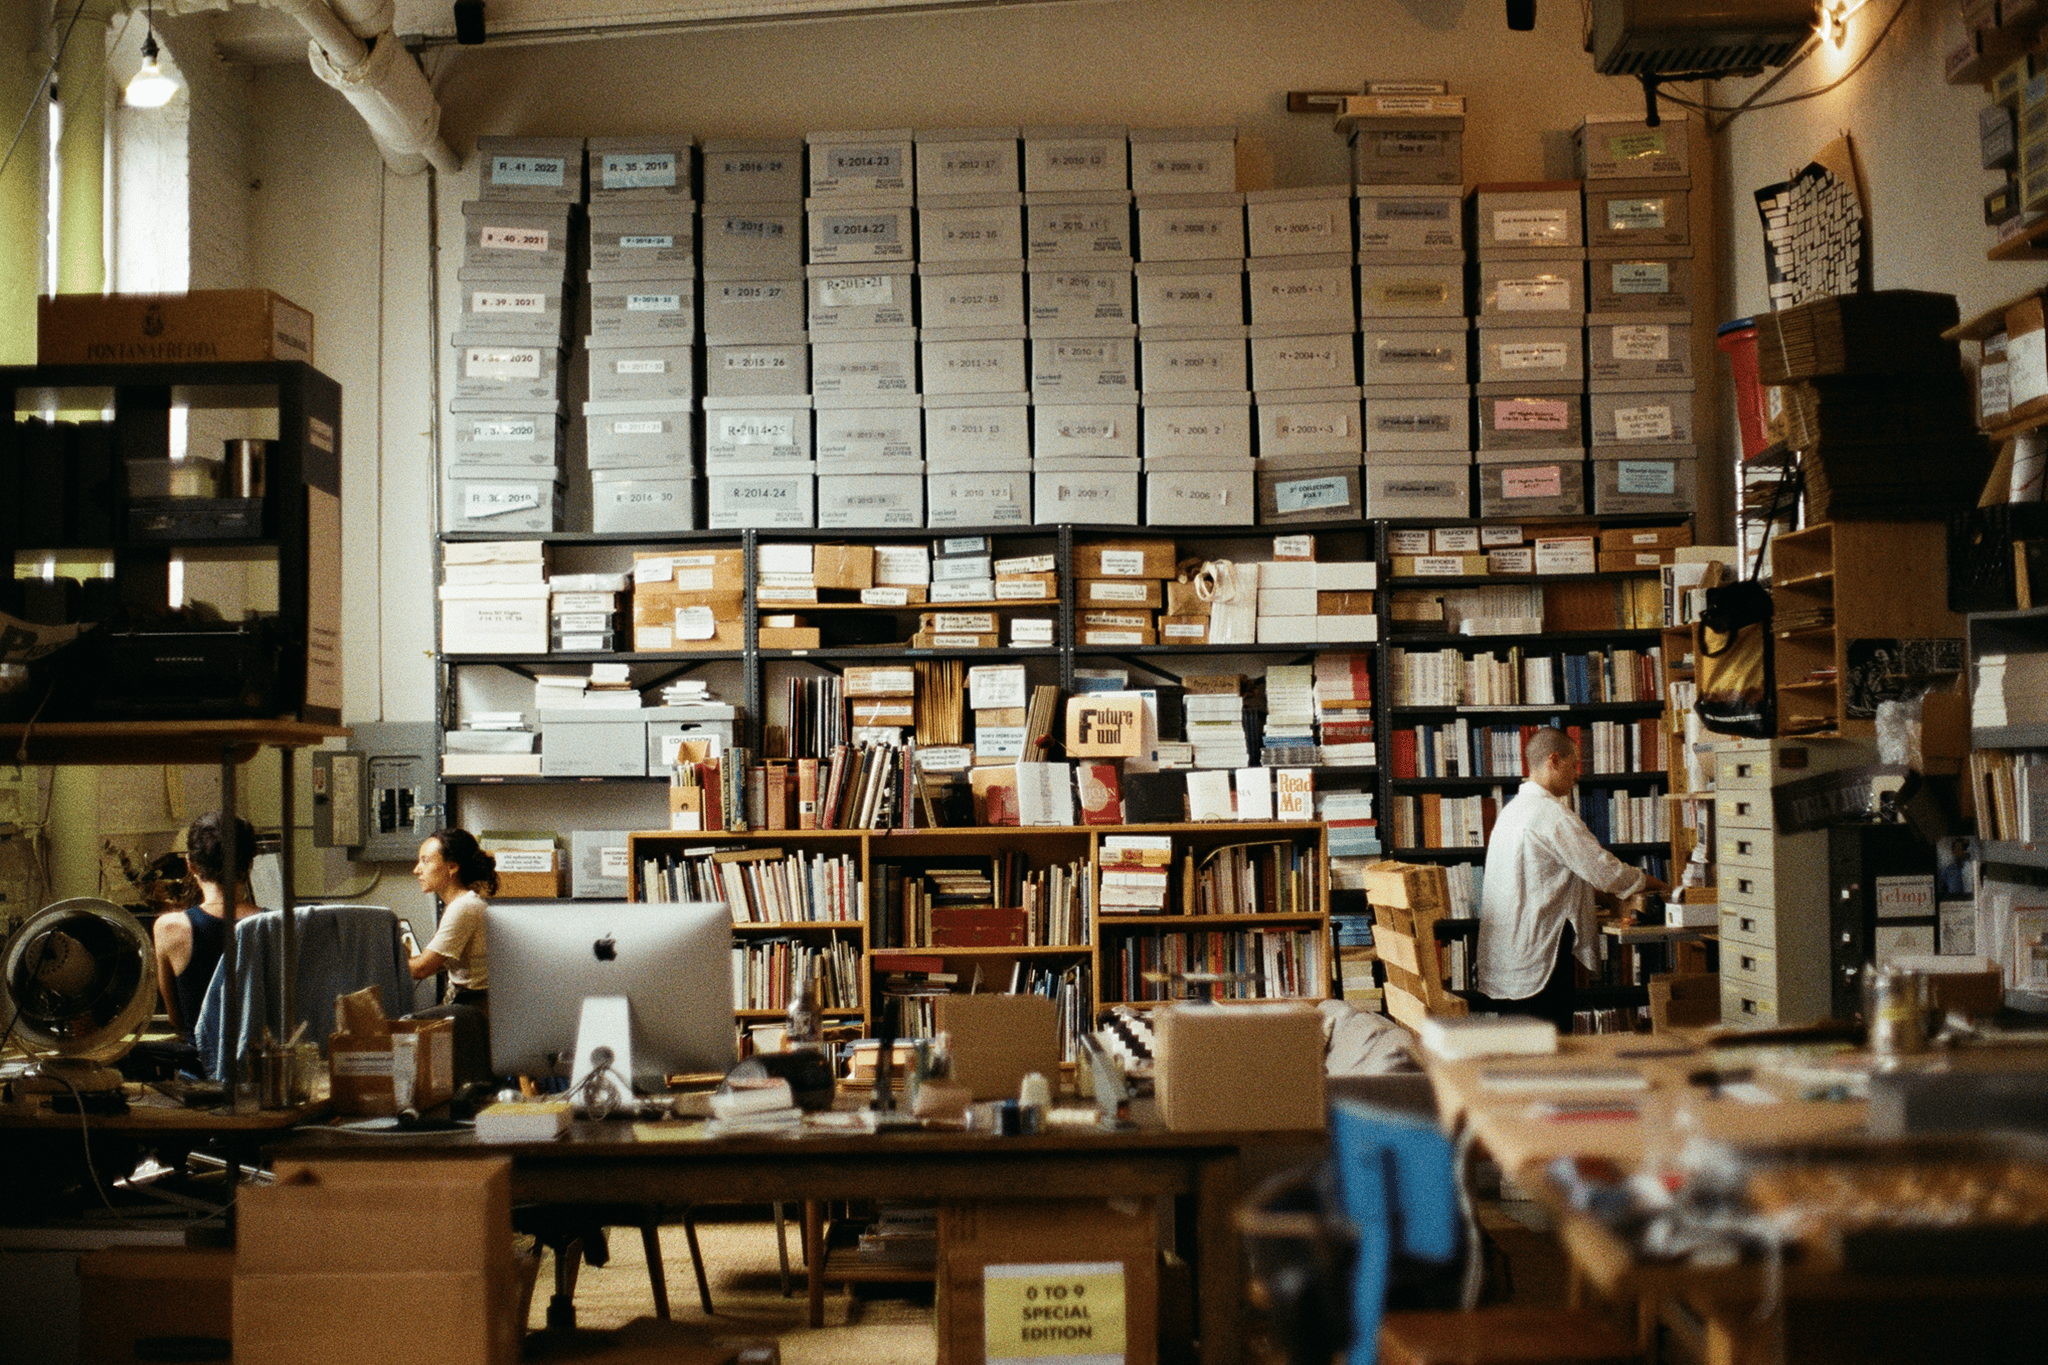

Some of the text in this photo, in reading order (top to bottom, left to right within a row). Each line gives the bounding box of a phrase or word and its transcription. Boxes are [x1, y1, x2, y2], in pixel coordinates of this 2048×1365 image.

[1280, 773, 1312, 792] Read
[1280, 797, 1302, 812] Me
[1043, 1284, 1069, 1300] TO
[1021, 1304, 1092, 1321] SPECIAL
[1021, 1323, 1093, 1341] EDITION
